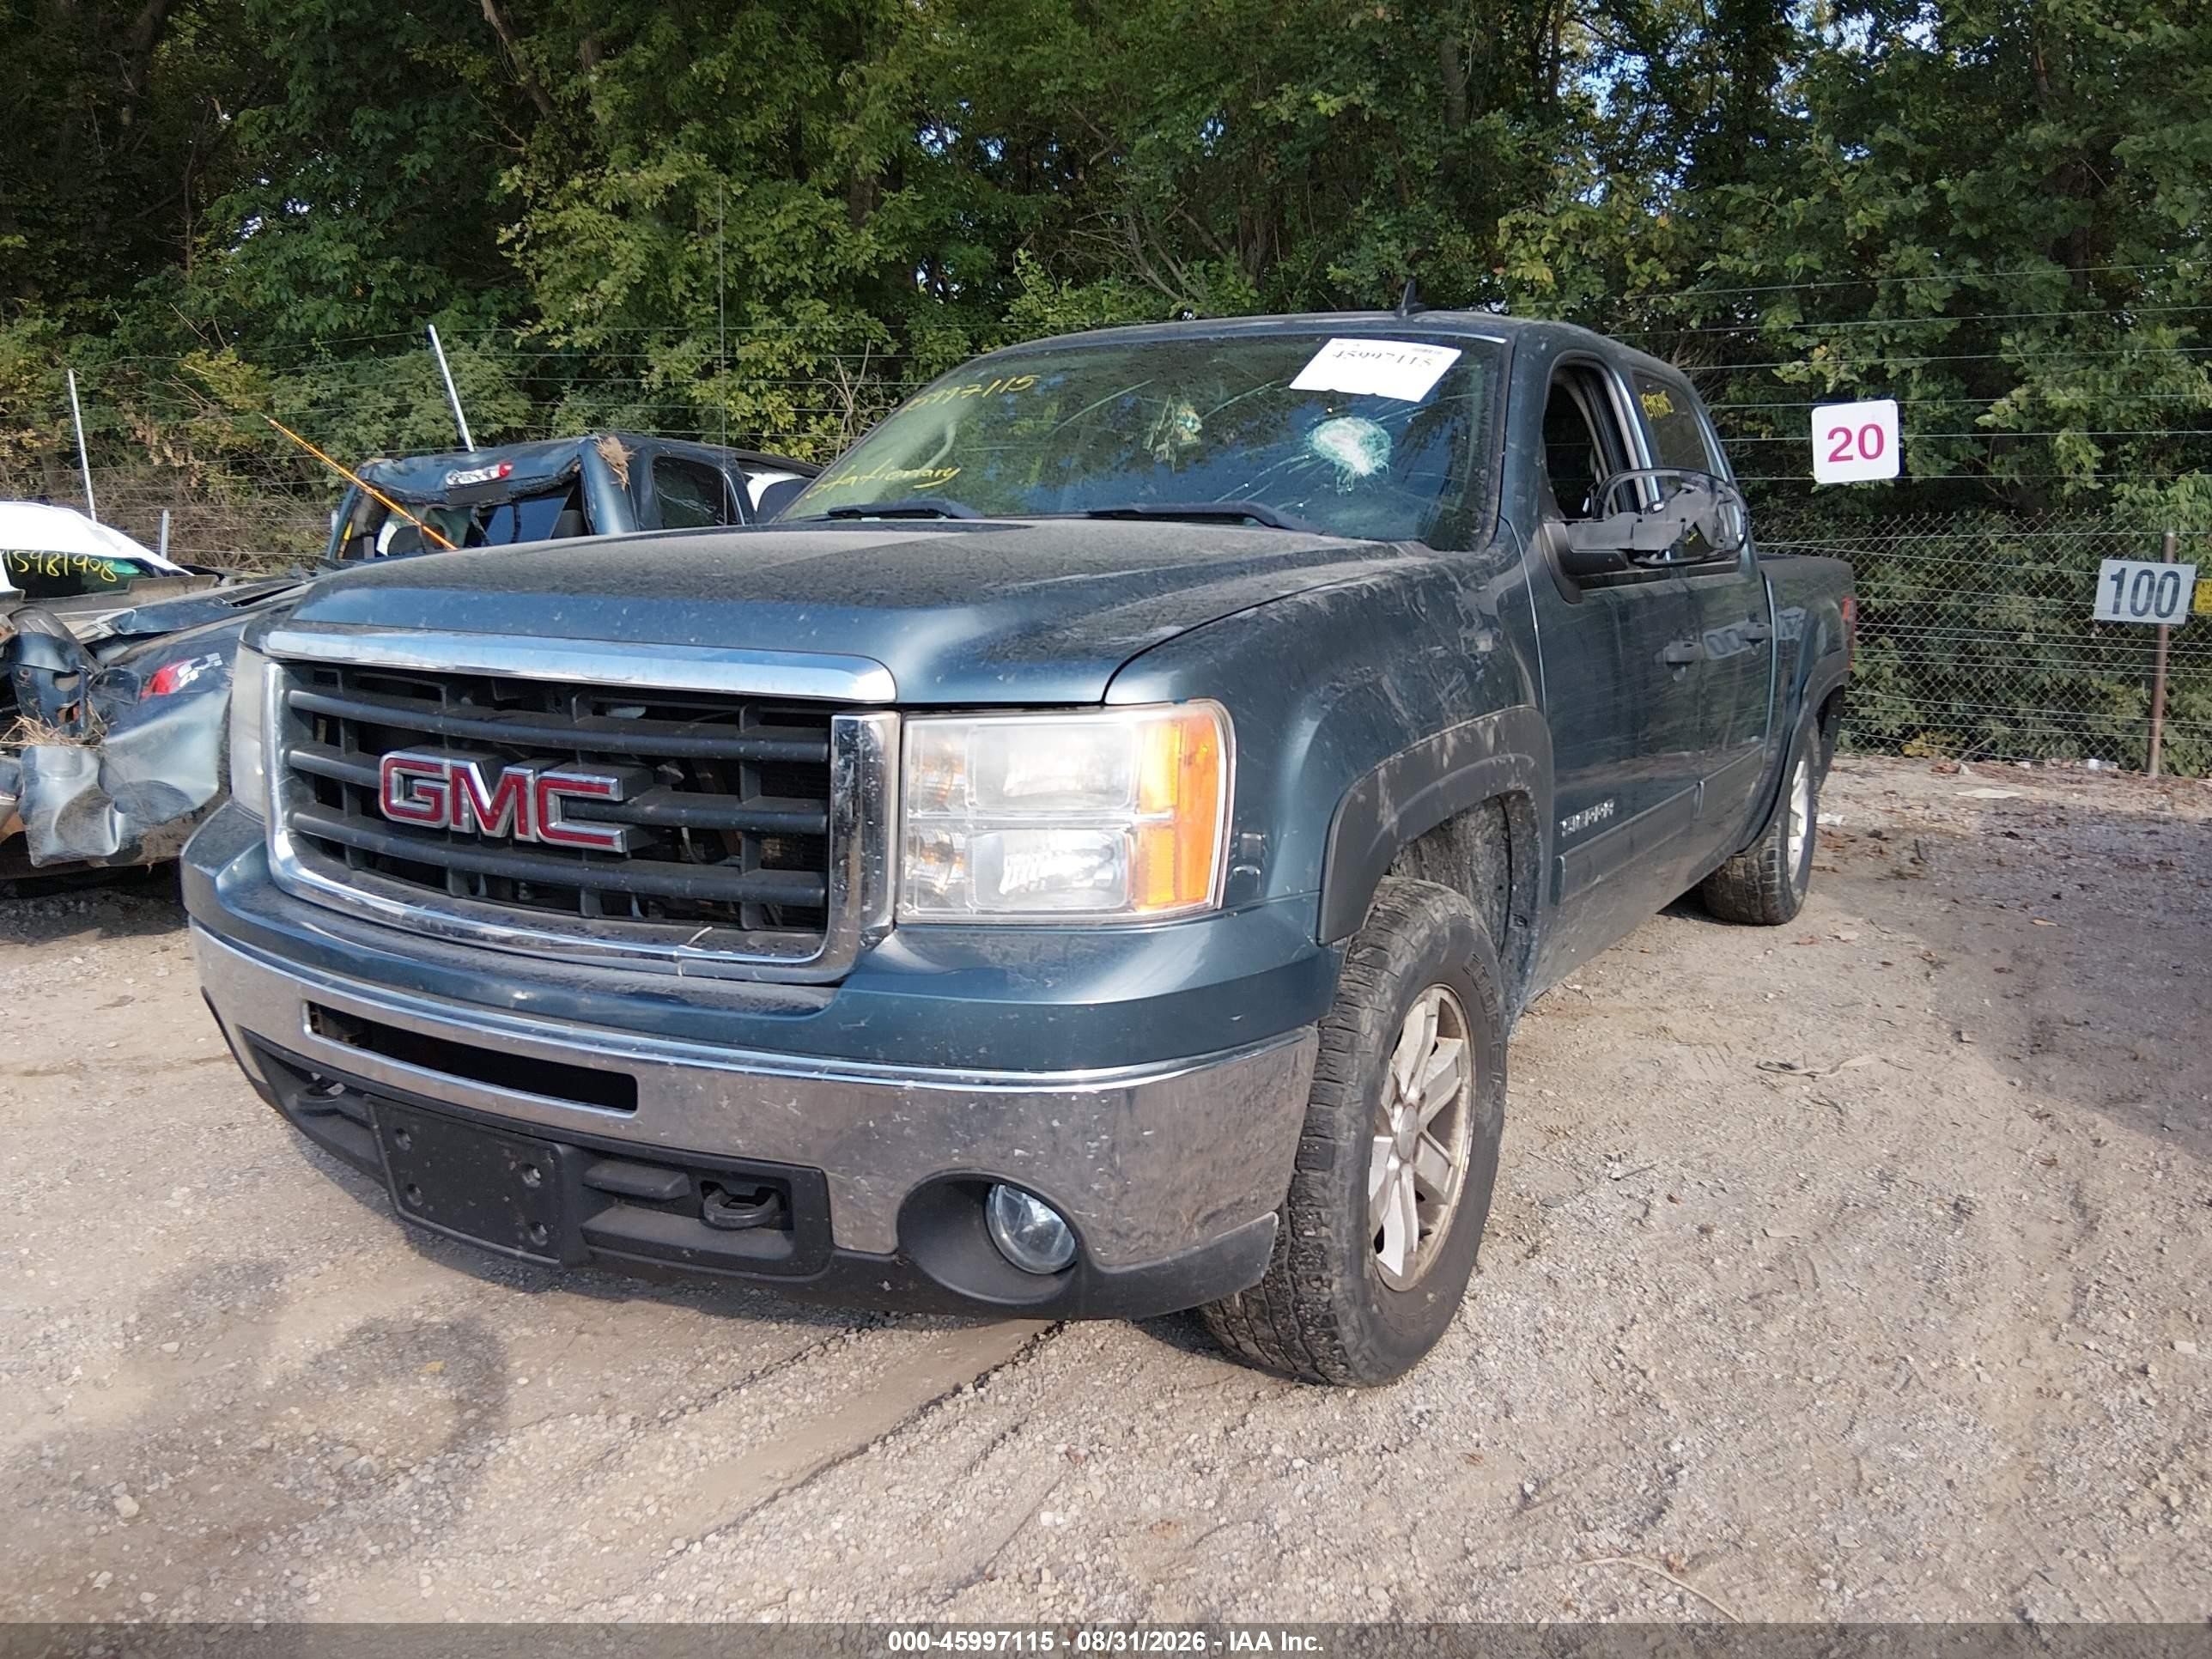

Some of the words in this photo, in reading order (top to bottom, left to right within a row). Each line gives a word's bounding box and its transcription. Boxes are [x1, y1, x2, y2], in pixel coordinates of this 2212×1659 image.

[1827, 423, 1884, 462] 20
[2110, 567, 2181, 618] 100
[379, 750, 628, 854] GMC
